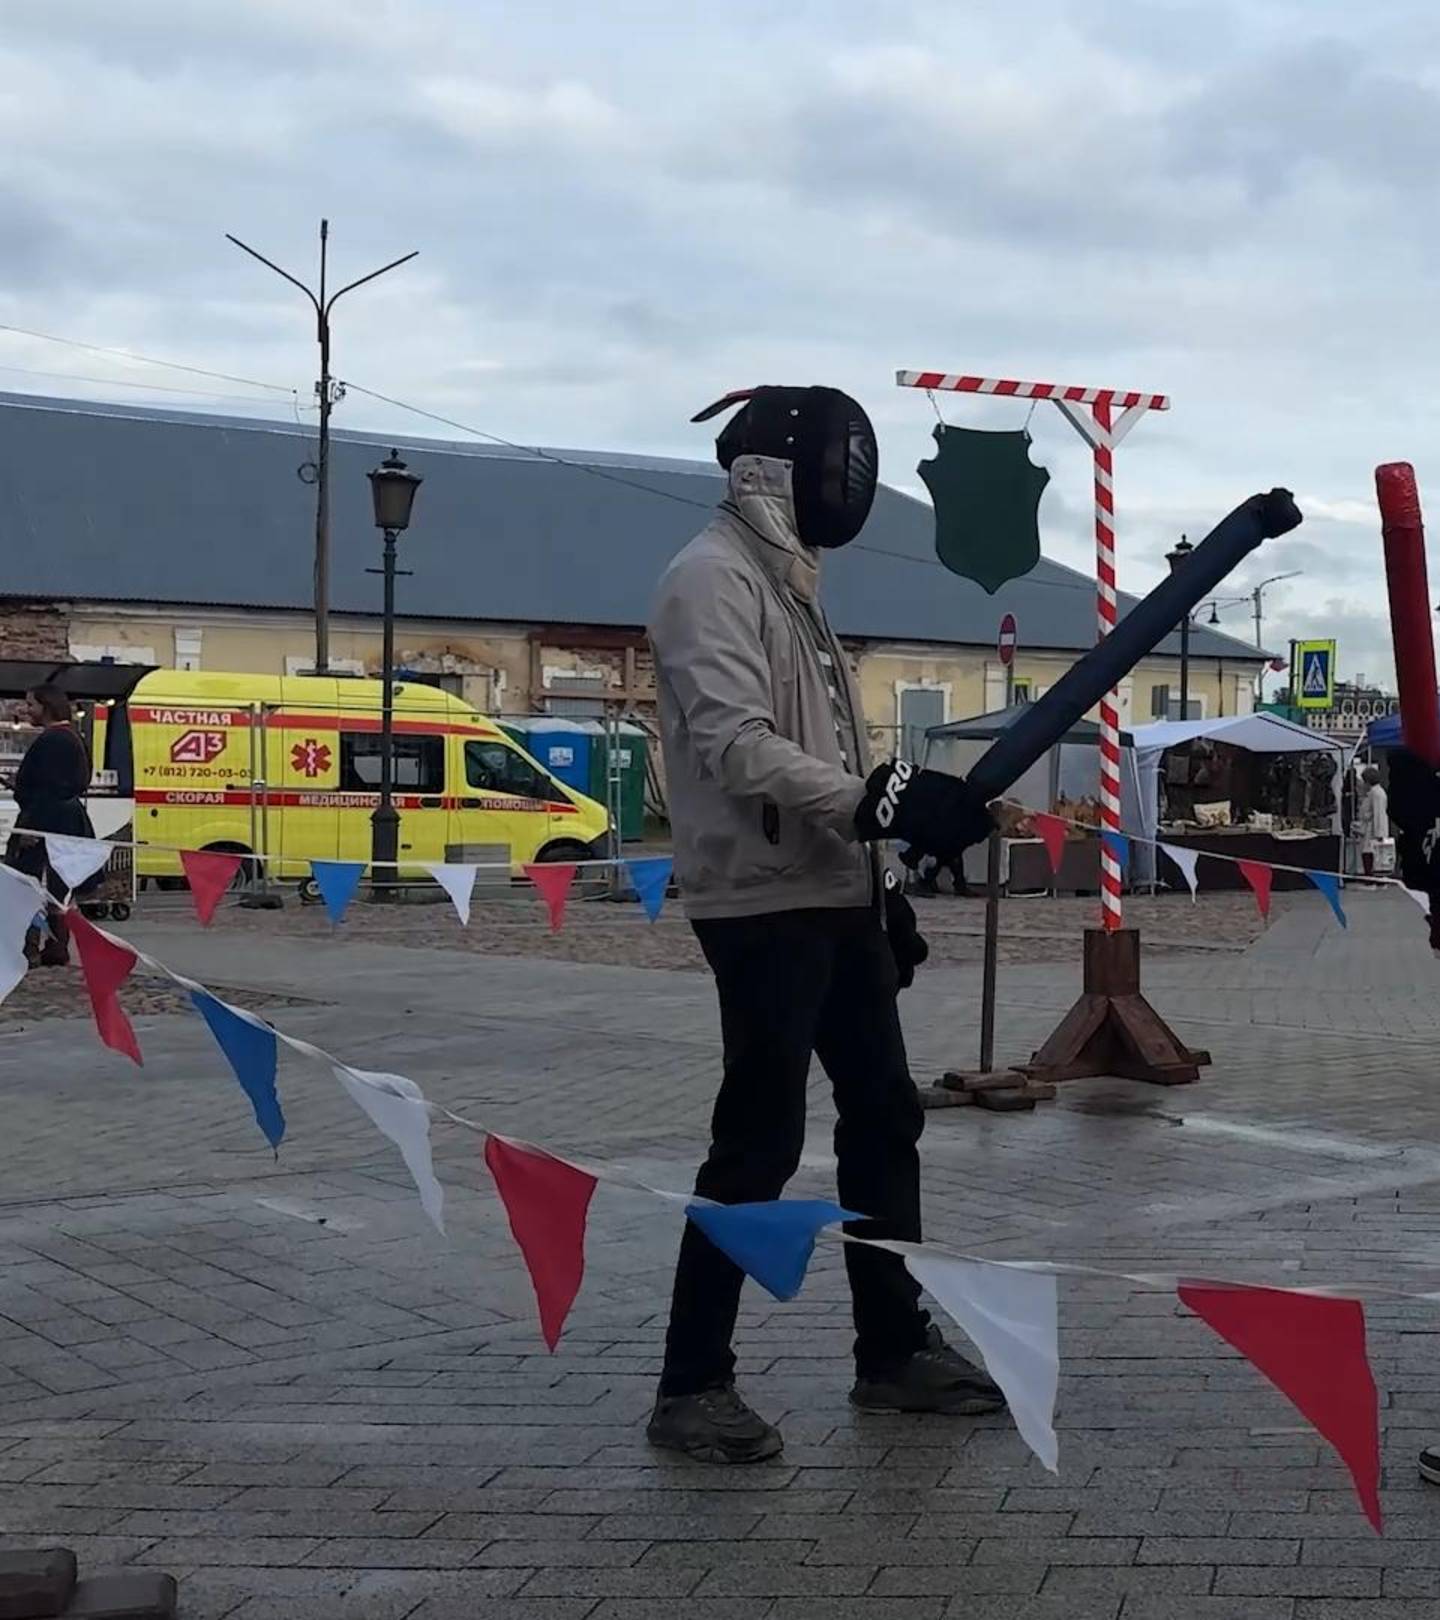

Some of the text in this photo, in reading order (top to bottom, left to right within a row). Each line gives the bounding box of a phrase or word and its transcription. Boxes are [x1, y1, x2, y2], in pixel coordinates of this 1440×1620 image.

[149, 710, 232, 725] ЧАСТНАЯ
[143, 766, 156, 776] +7
[158, 766, 187, 777] (812)
[165, 792, 225, 803] СКОРАЯ
[299, 796, 405, 807] МЕДИЦИНСАЯ
